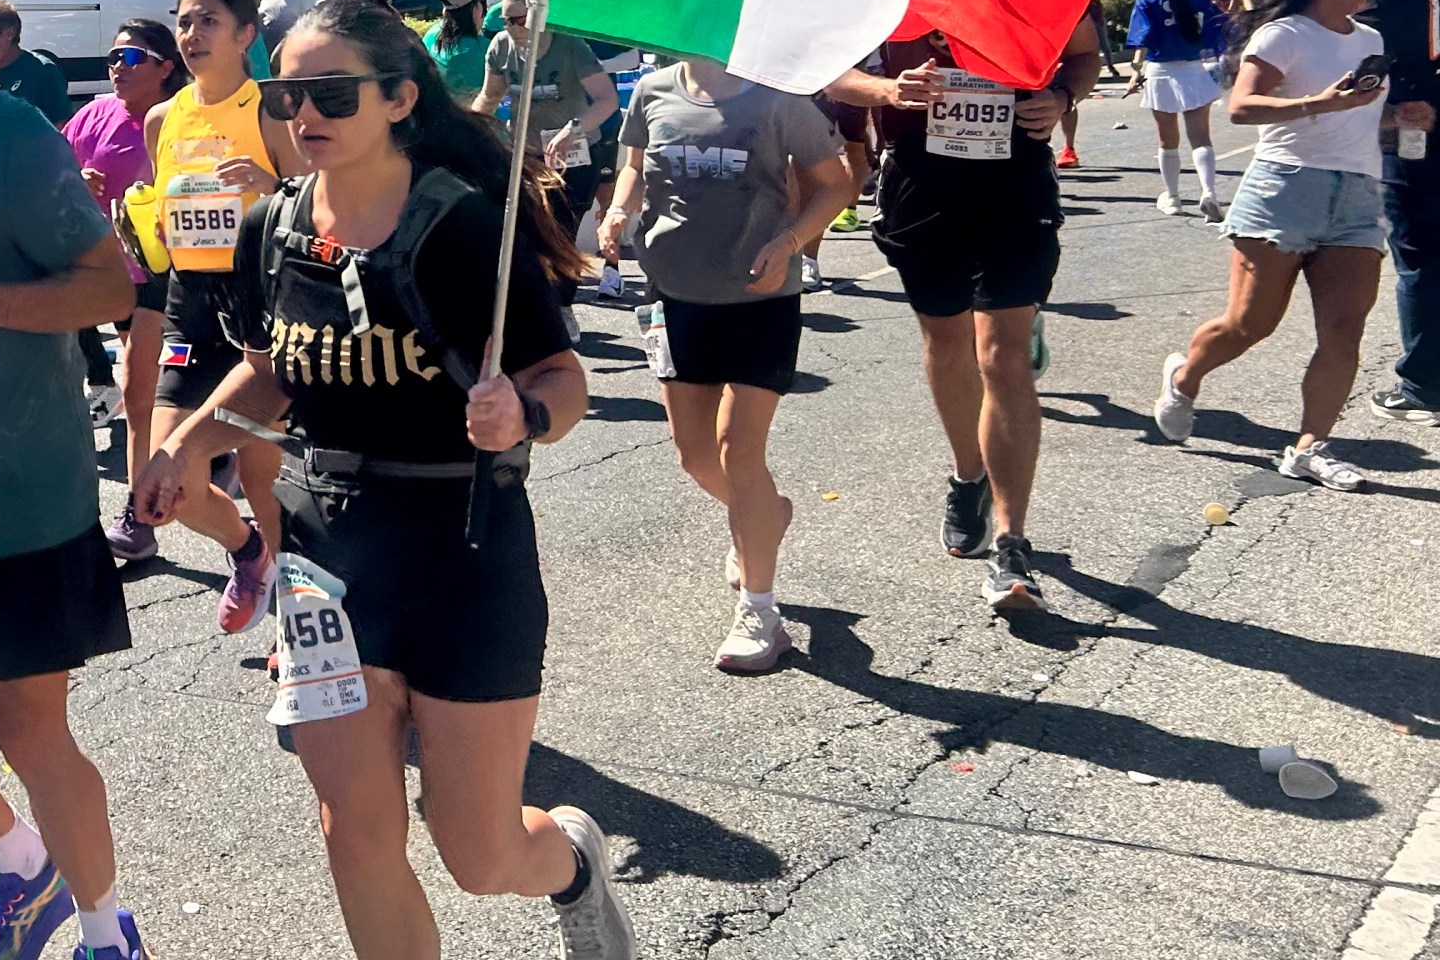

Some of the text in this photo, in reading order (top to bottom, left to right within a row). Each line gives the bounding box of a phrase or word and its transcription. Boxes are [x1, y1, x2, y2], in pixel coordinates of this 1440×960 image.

[950, 81, 995, 89] MARATHON
[932, 101, 1011, 123] C4093
[944, 143, 969, 153] C4093
[170, 208, 236, 231] 15586
[281, 608, 344, 652] 458
[340, 689, 355, 699] ONE
[341, 697, 361, 706] DRINK
